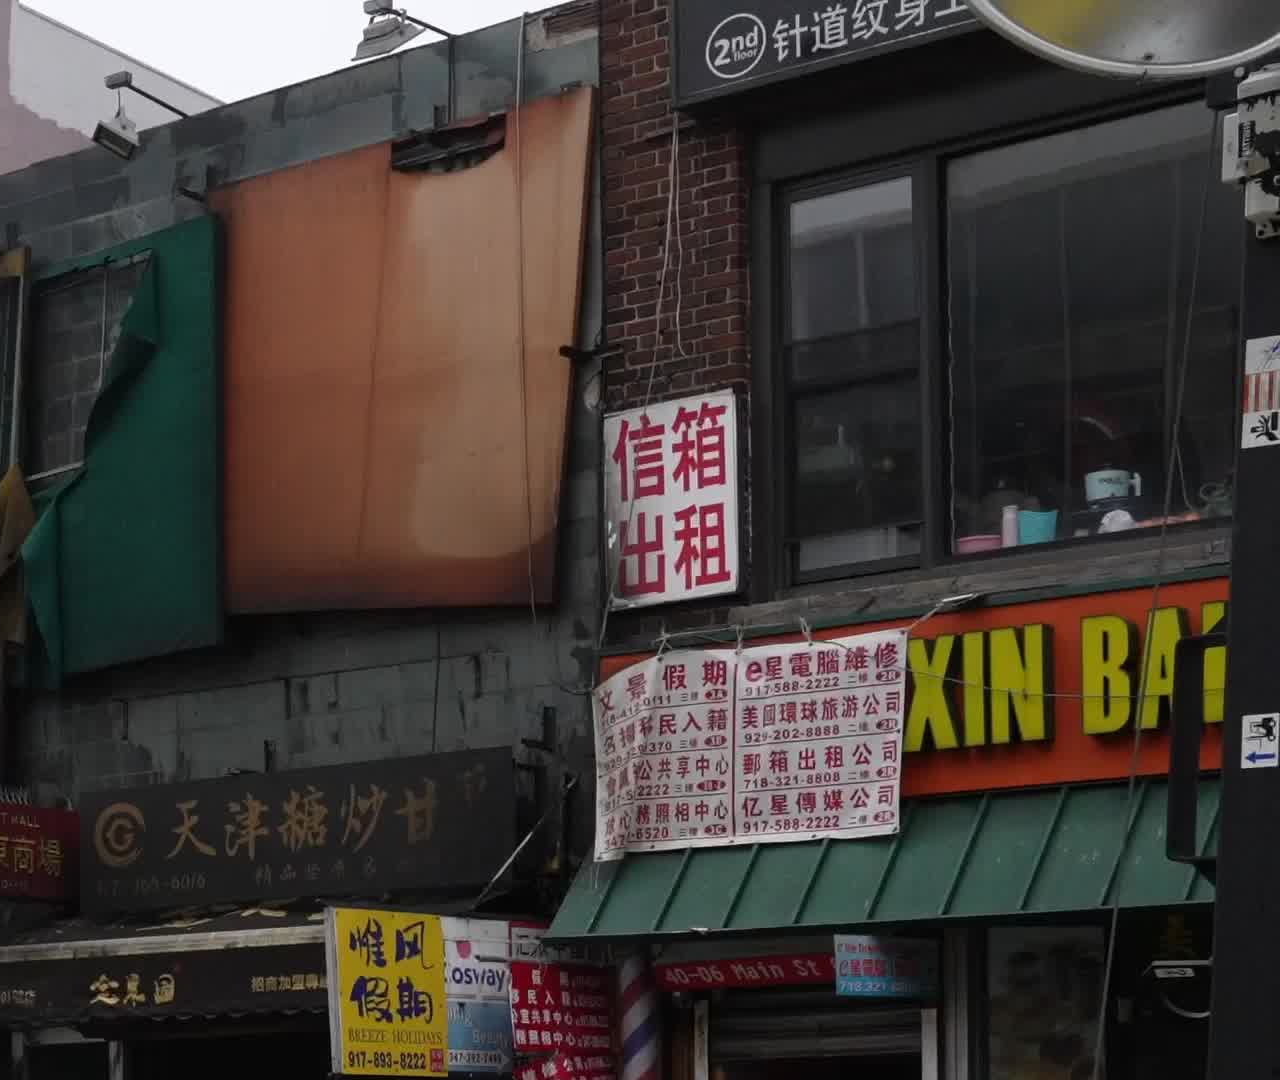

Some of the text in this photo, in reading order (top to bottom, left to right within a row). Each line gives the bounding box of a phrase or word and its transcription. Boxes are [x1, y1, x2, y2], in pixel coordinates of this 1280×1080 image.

[713, 28, 760, 66] 2nd
[773, 0, 968, 61] 针道纹身
[612, 401, 729, 503] 信箱
[617, 502, 732, 597] 出租
[903, 623, 1053, 754] XIN
[162, 777, 486, 862] 天津糖炒甘
[446, 966, 507, 992] osway
[729, 961, 785, 981] Main
[793, 958, 822, 977] St
[348, 1027, 444, 1045] BREEZE HOLIDAYS
[348, 1050, 428, 1070] 917-893-8222
